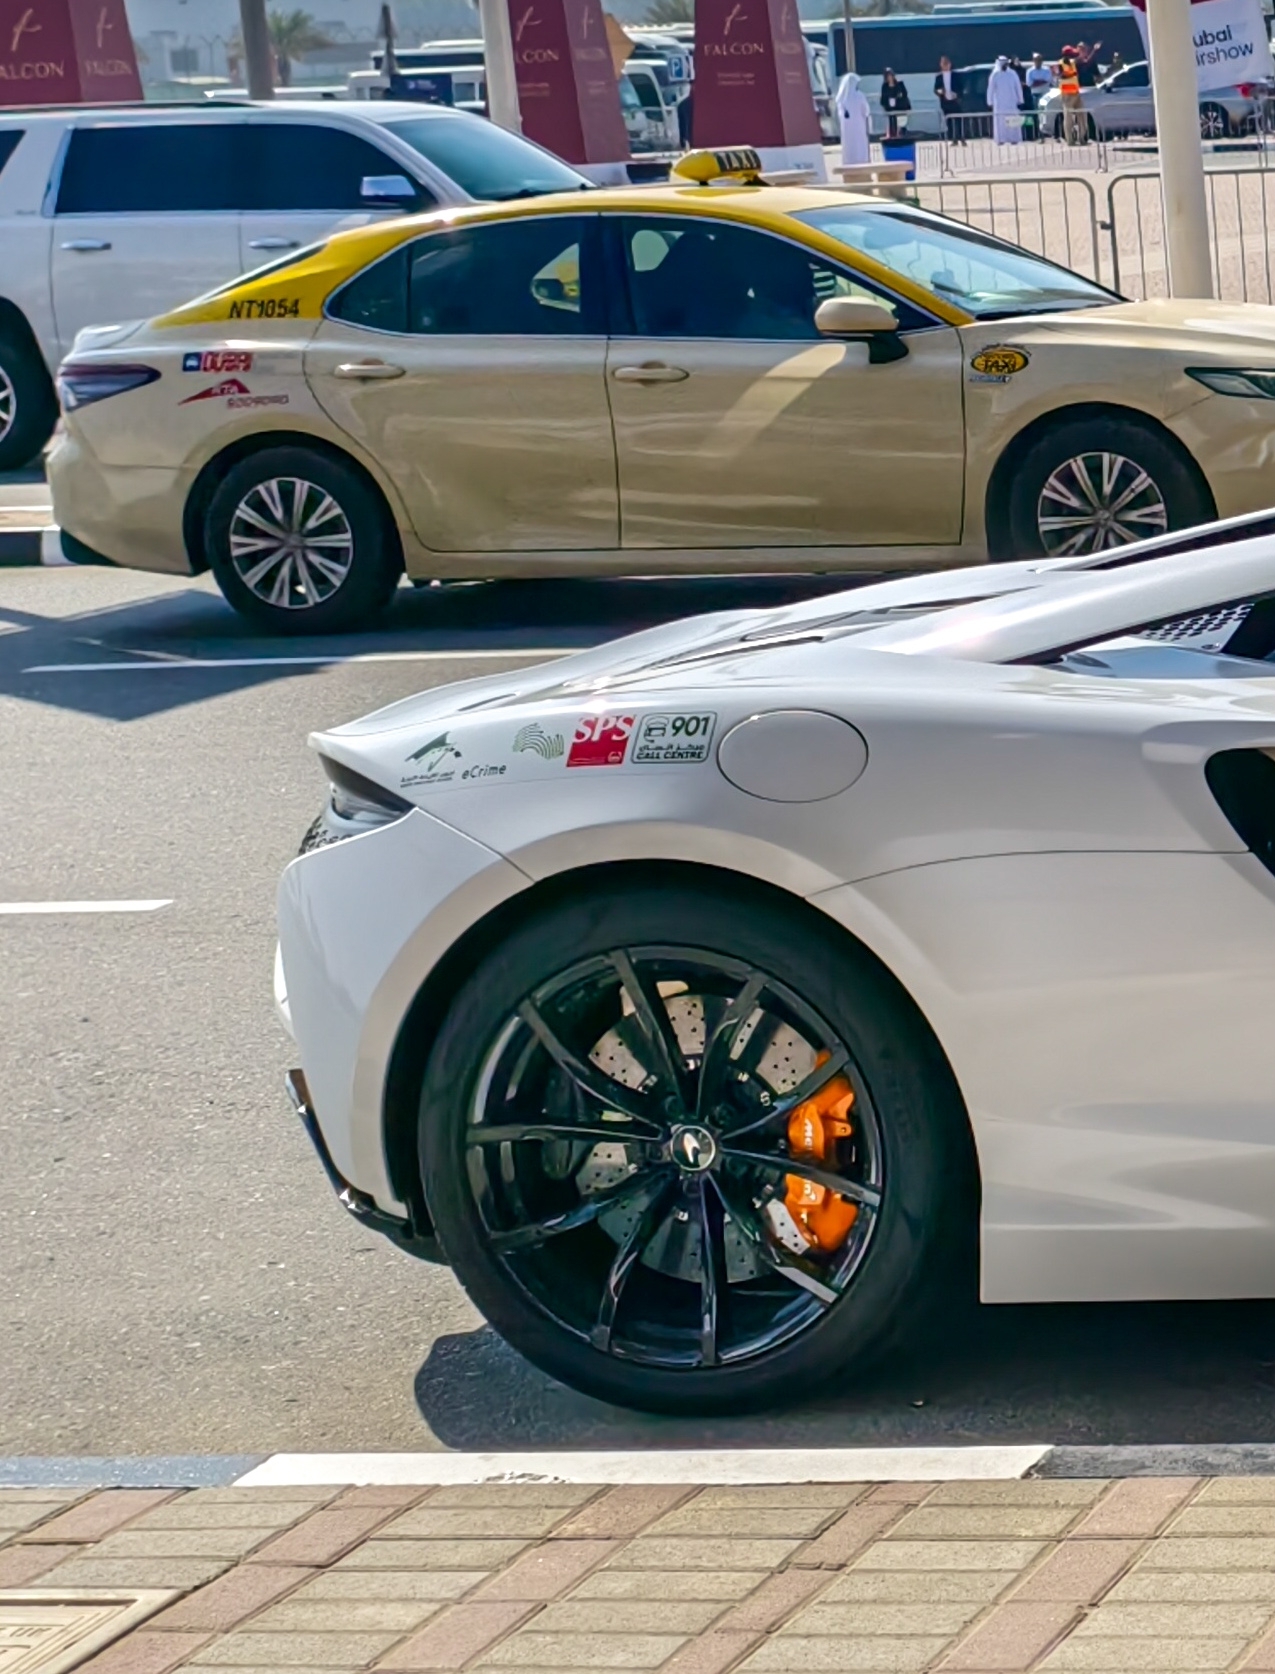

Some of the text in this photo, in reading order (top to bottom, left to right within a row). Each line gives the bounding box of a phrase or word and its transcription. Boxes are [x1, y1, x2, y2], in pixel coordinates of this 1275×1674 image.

[1192, 24, 1232, 48] ubai
[704, 42, 764, 56] FALCON
[1195, 42, 1253, 66] irshow
[0, 61, 64, 79] ALCON
[717, 150, 757, 170] TAXI
[229, 299, 301, 319] NT1054
[573, 714, 635, 743] SPS
[672, 716, 711, 737] 901
[664, 751, 704, 760] CENTRE
[461, 764, 507, 780] eCrime
